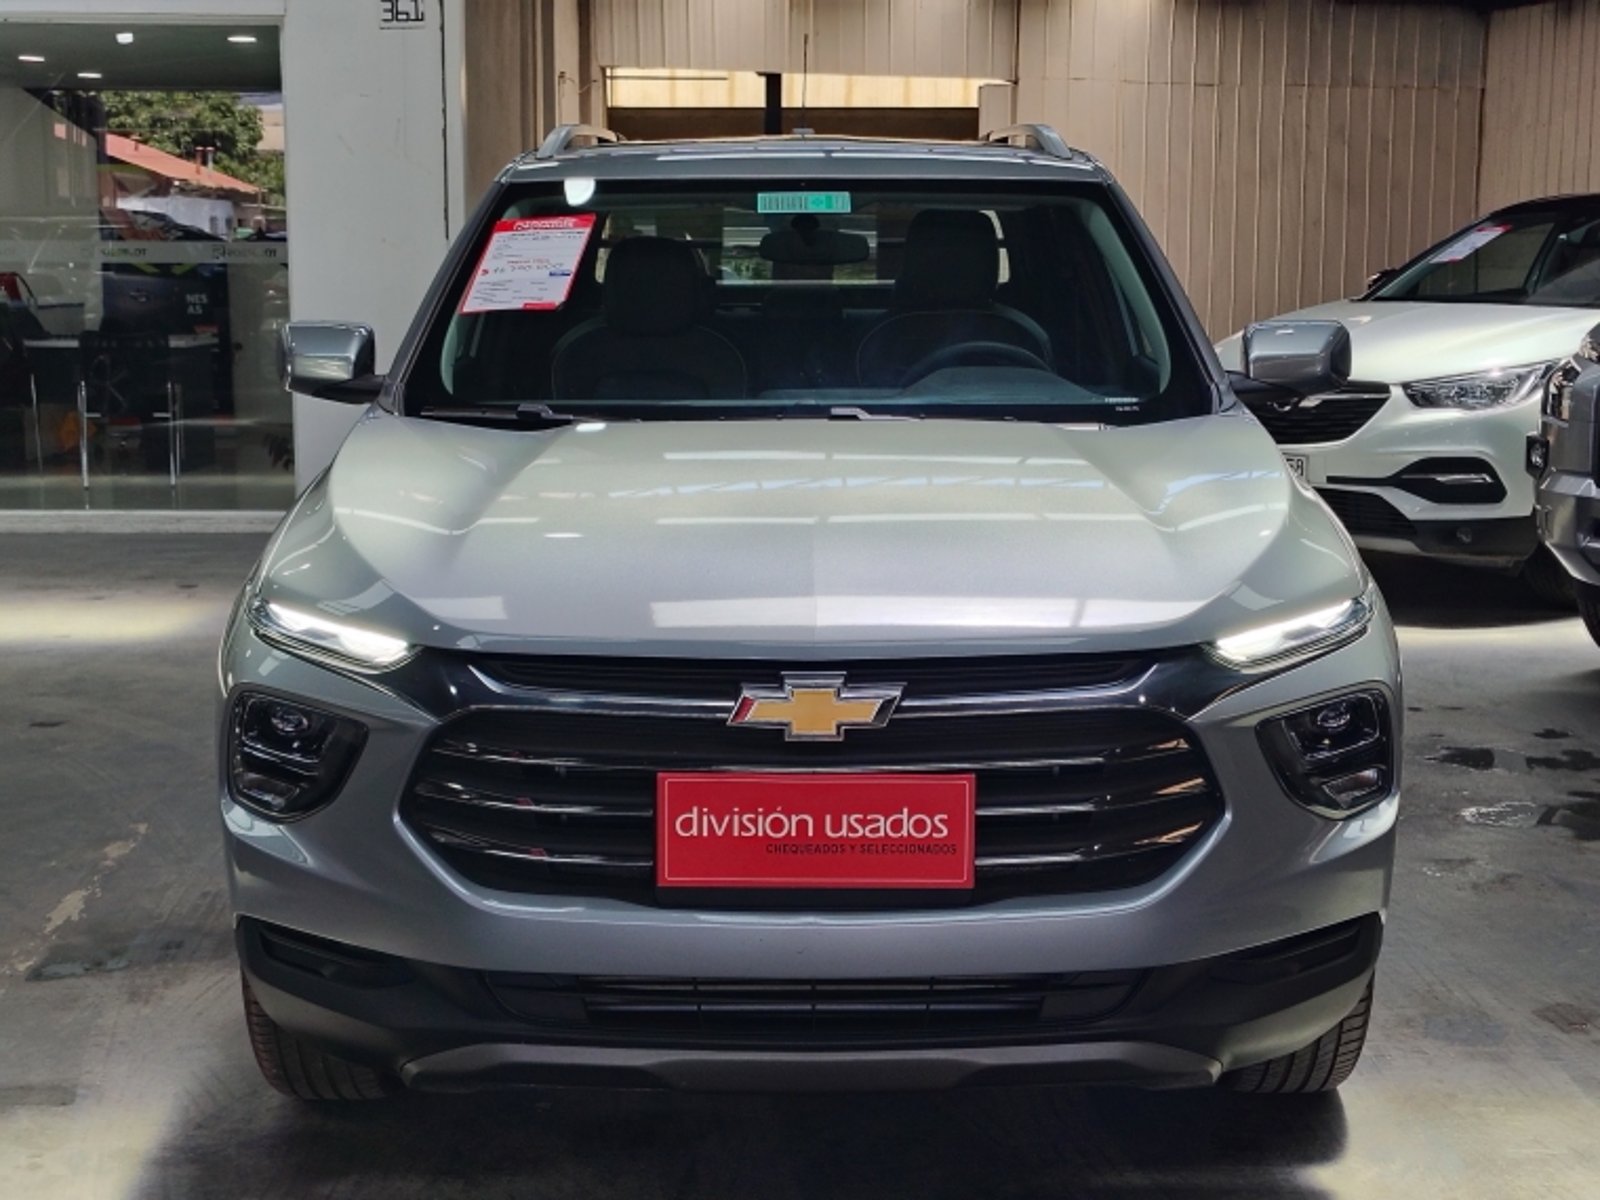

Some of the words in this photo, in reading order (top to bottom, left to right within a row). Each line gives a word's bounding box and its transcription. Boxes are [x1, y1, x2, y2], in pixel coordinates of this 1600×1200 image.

[675, 805, 814, 839] división
[824, 806, 949, 839] usados
[765, 843, 846, 855] CHEQUEADOS
[849, 843, 857, 854] Y
[860, 843, 957, 856] SELECCIONADOS
